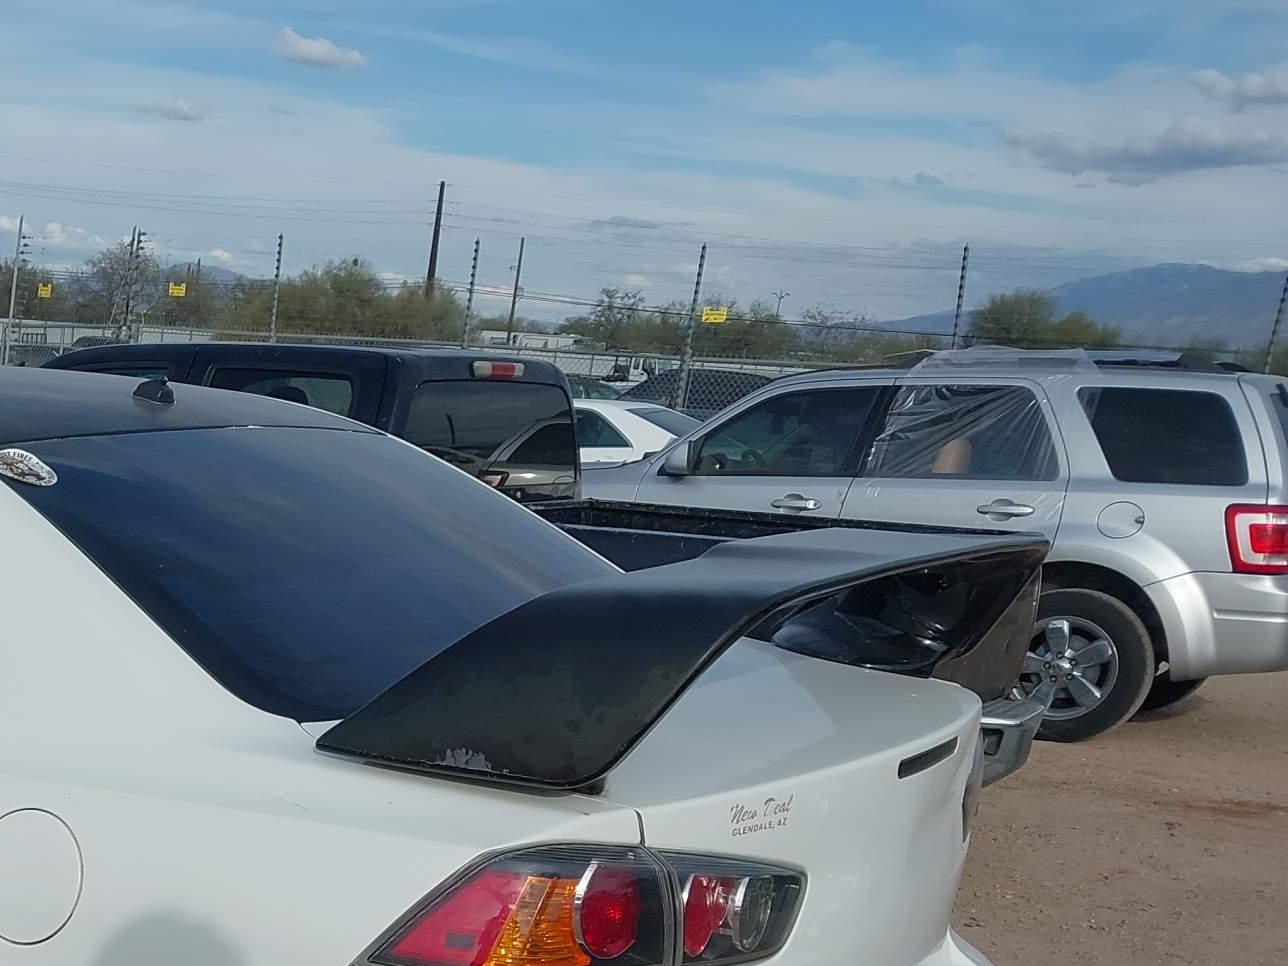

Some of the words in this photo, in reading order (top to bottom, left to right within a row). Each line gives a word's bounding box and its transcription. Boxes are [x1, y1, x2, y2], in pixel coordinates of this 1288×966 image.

[12, 451, 33, 462] FIRES
[730, 803, 758, 824] New
[732, 820, 774, 836] GLENDALE,
[777, 817, 787, 826] AZ
